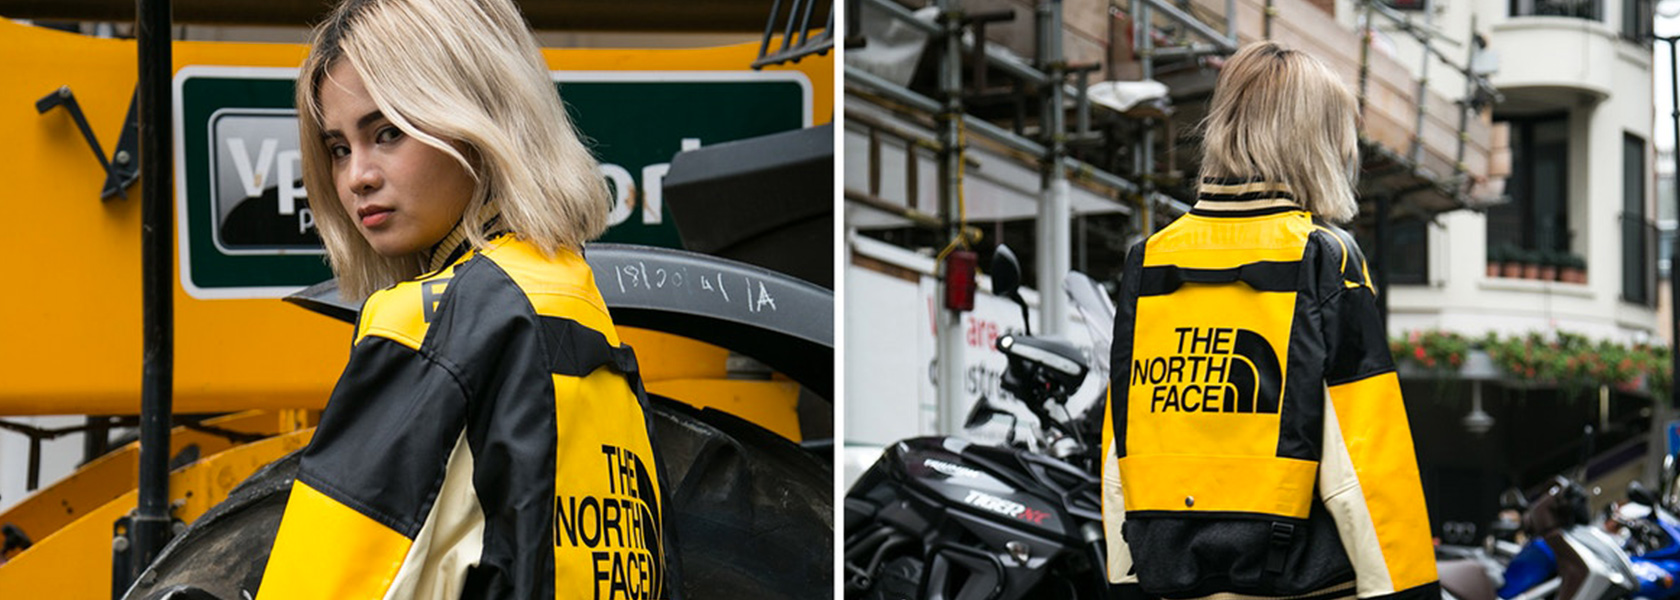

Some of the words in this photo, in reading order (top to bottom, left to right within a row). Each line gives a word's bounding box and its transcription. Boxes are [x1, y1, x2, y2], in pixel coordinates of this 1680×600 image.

[226, 137, 308, 215] Vp
[1174, 327, 1234, 355] THE
[1131, 356, 1229, 387] NORTH
[1150, 384, 1223, 414] FACE
[601, 443, 638, 499] THE
[555, 495, 645, 550] NORTH
[963, 488, 1026, 518] TIGER
[591, 551, 650, 600] FACE
